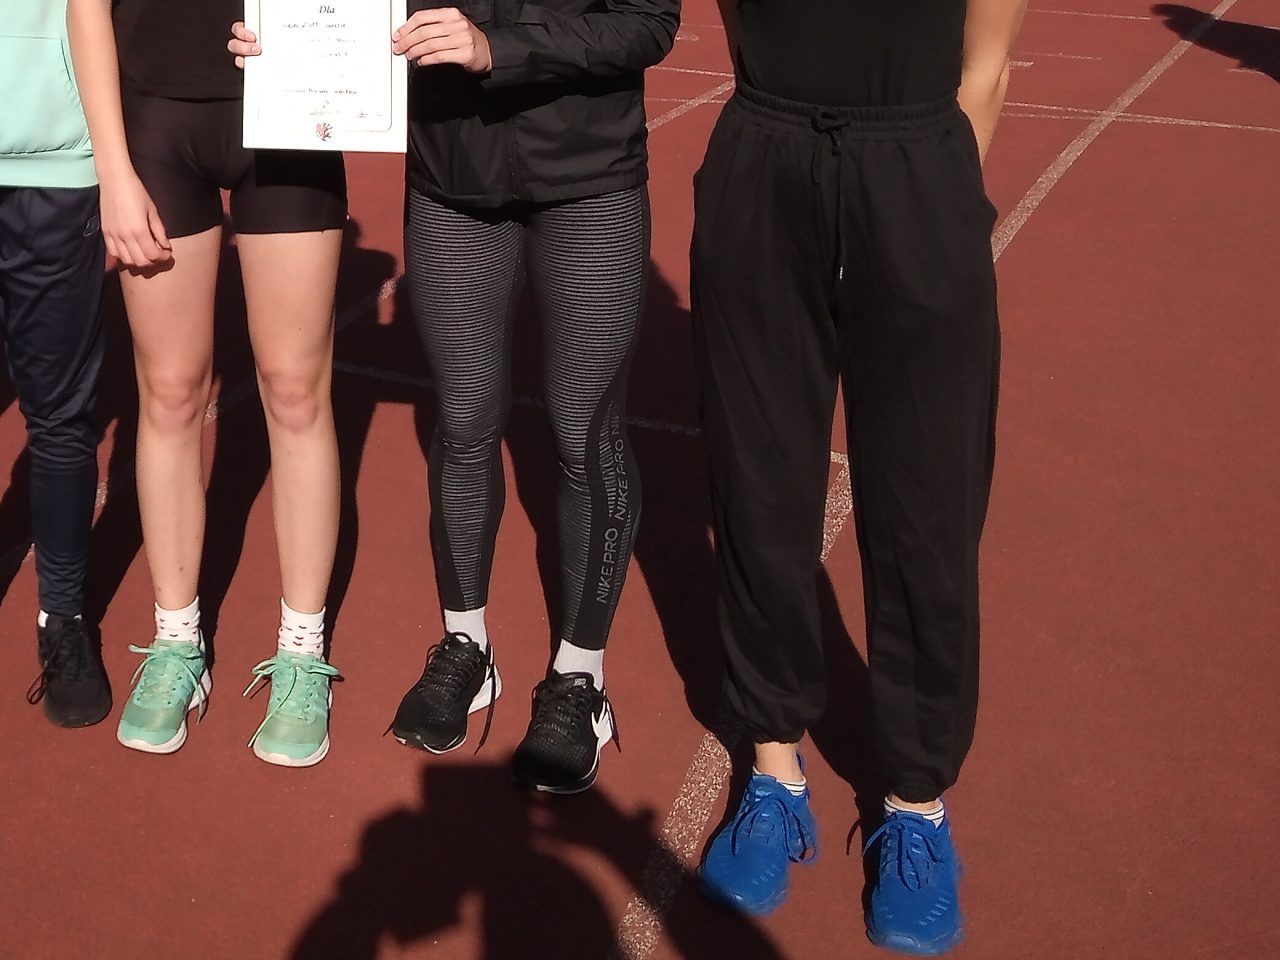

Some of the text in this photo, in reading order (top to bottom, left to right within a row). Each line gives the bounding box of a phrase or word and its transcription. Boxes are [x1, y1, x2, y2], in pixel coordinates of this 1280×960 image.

[319, 4, 336, 14] Dla
[615, 439, 626, 475] PRO
[615, 477, 628, 520] NIKE
[596, 527, 618, 604] NIKE PRO
